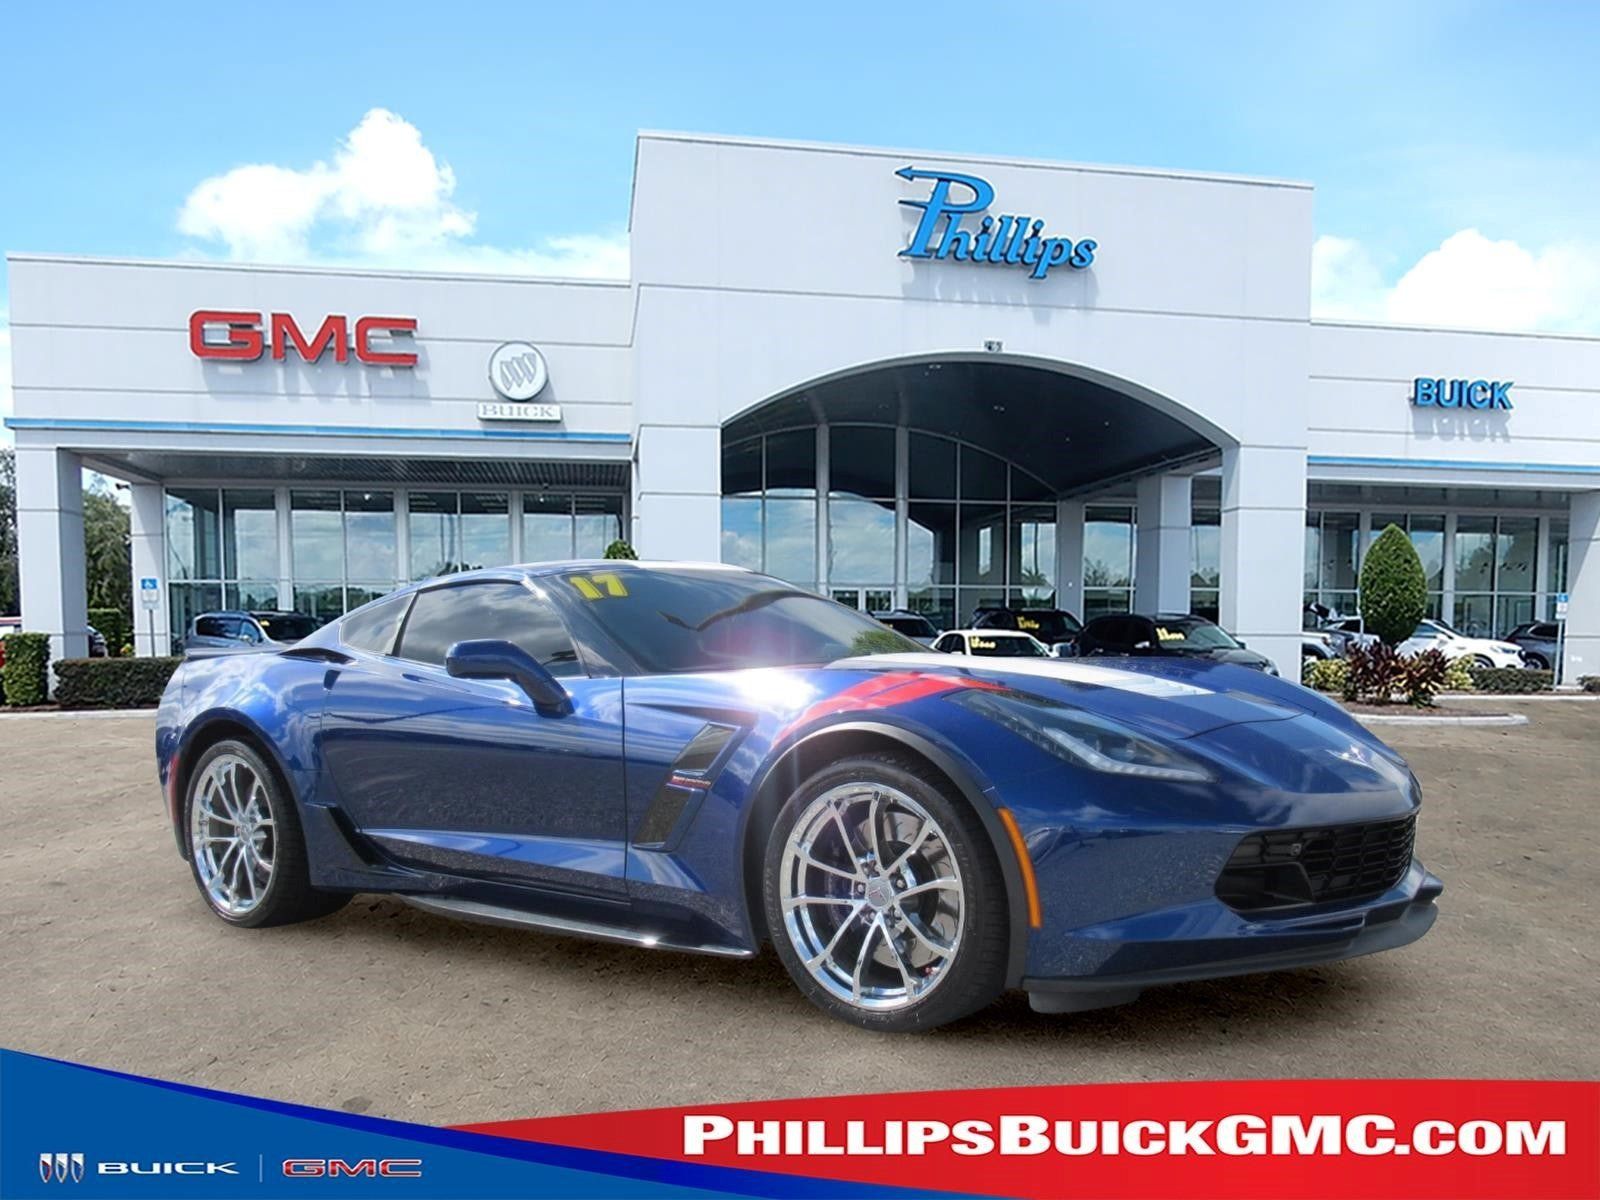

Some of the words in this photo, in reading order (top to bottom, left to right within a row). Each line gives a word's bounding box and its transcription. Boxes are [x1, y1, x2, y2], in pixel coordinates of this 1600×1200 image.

[895, 166, 1098, 280] Phillips
[189, 310, 418, 368] GMC
[1414, 377, 1513, 410] BUICK
[481, 404, 554, 418] BUICK
[570, 574, 628, 599] 17
